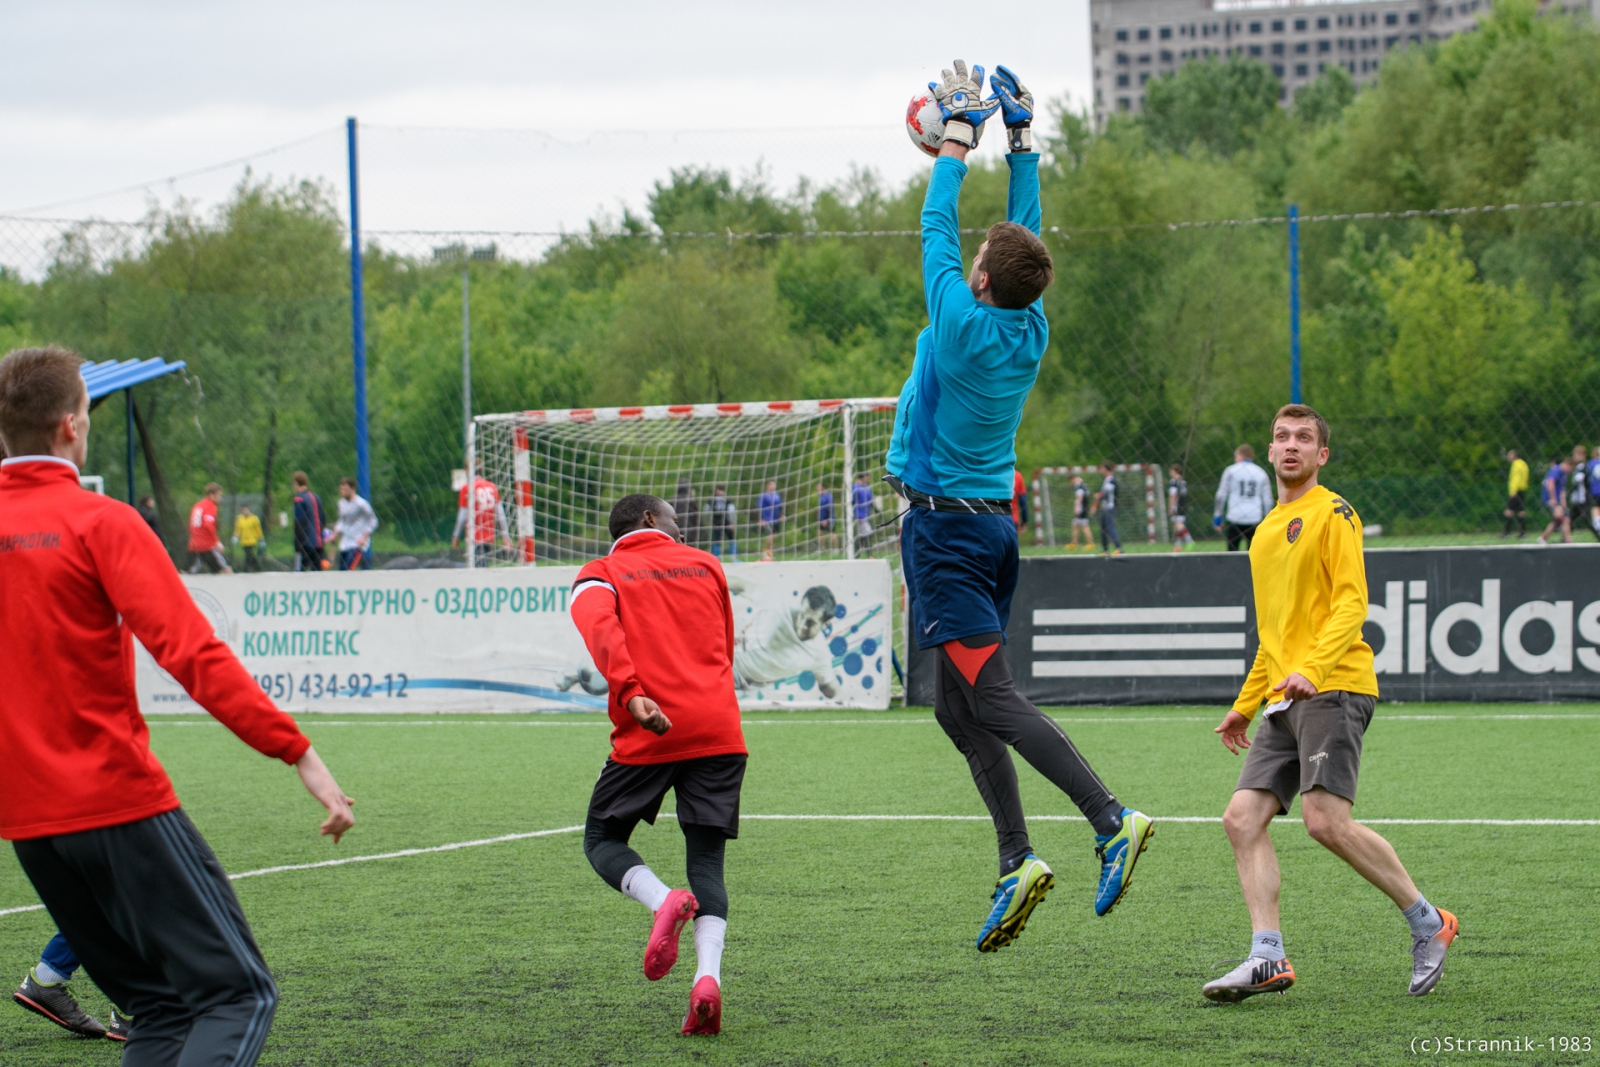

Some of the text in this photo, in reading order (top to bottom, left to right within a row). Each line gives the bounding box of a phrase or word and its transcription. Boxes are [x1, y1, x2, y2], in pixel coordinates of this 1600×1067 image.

[1239, 480, 1257, 498] 13
[243, 588, 416, 618] ФИЗКУЛЬТУРНО
[434, 586, 571, 619] ОЗДОРОВИТ
[243, 630, 361, 657] КОМПЛЕКС
[255, 671, 409, 703] 95) 434-92-12
[1250, 957, 1292, 986] NIKE
